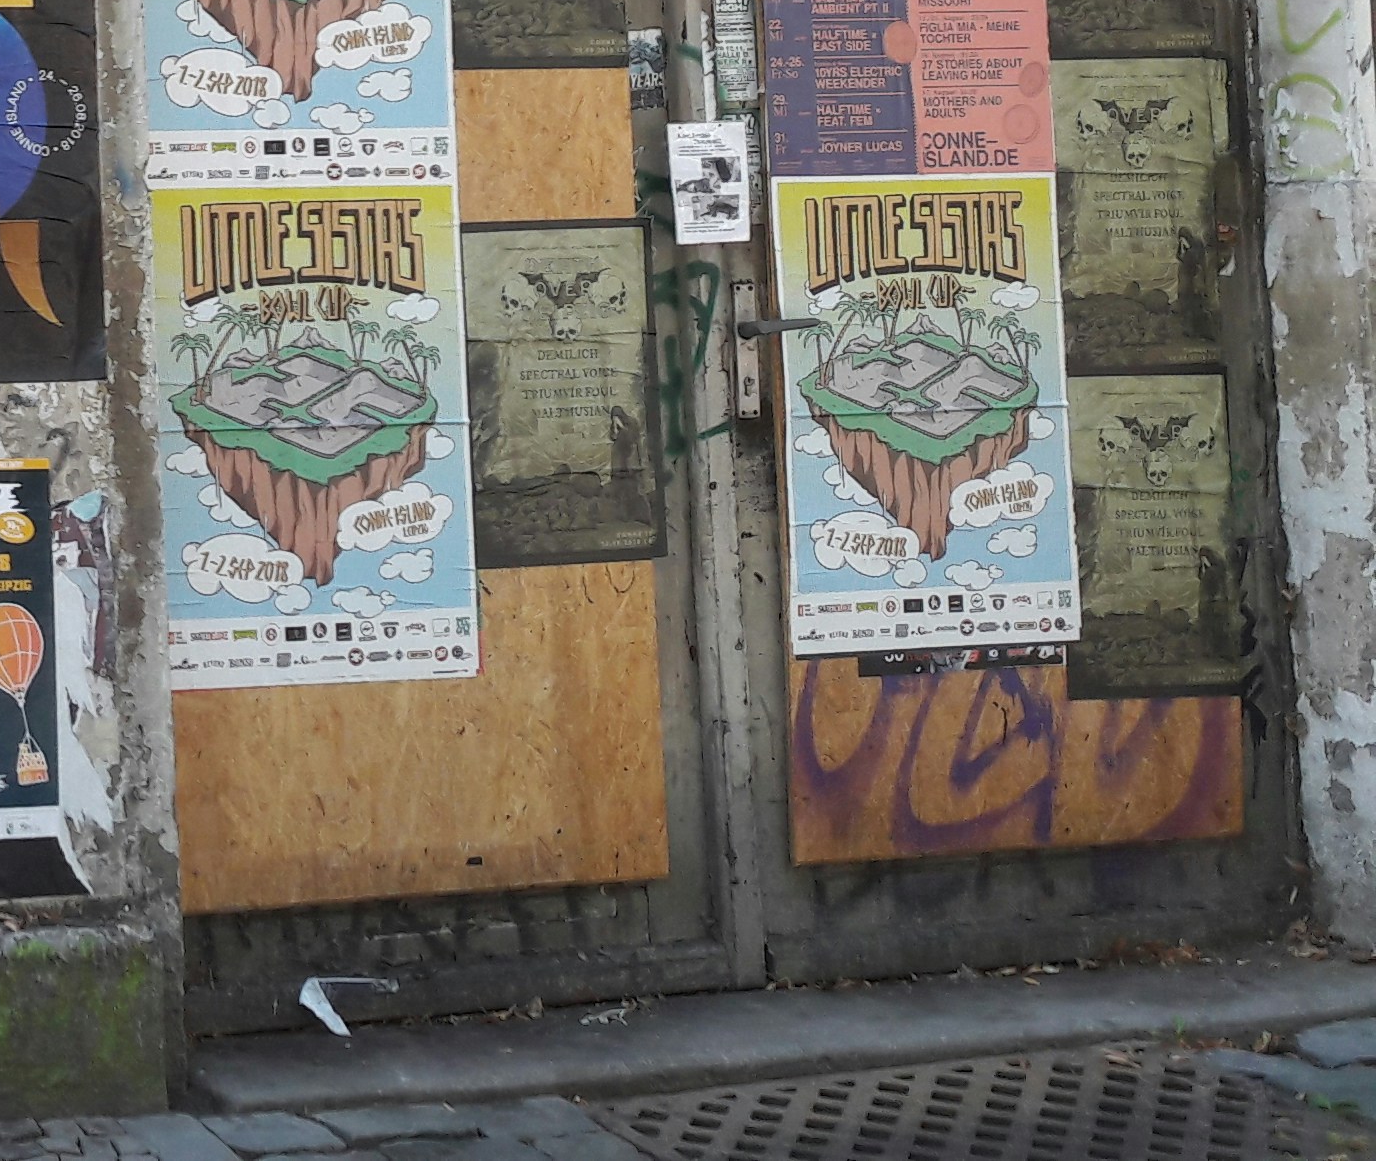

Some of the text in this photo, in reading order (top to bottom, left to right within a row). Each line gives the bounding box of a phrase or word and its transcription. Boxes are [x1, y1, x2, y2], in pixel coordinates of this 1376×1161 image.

[813, 40, 871, 51] EAST SIDE
[921, 34, 971, 44] TOCHTER
[818, 141, 903, 154] JOYNER LUCAS
[923, 149, 1020, 168] ISLAND.DE
[805, 194, 910, 295] LITTLE
[876, 275, 962, 311] BOWL CUP
